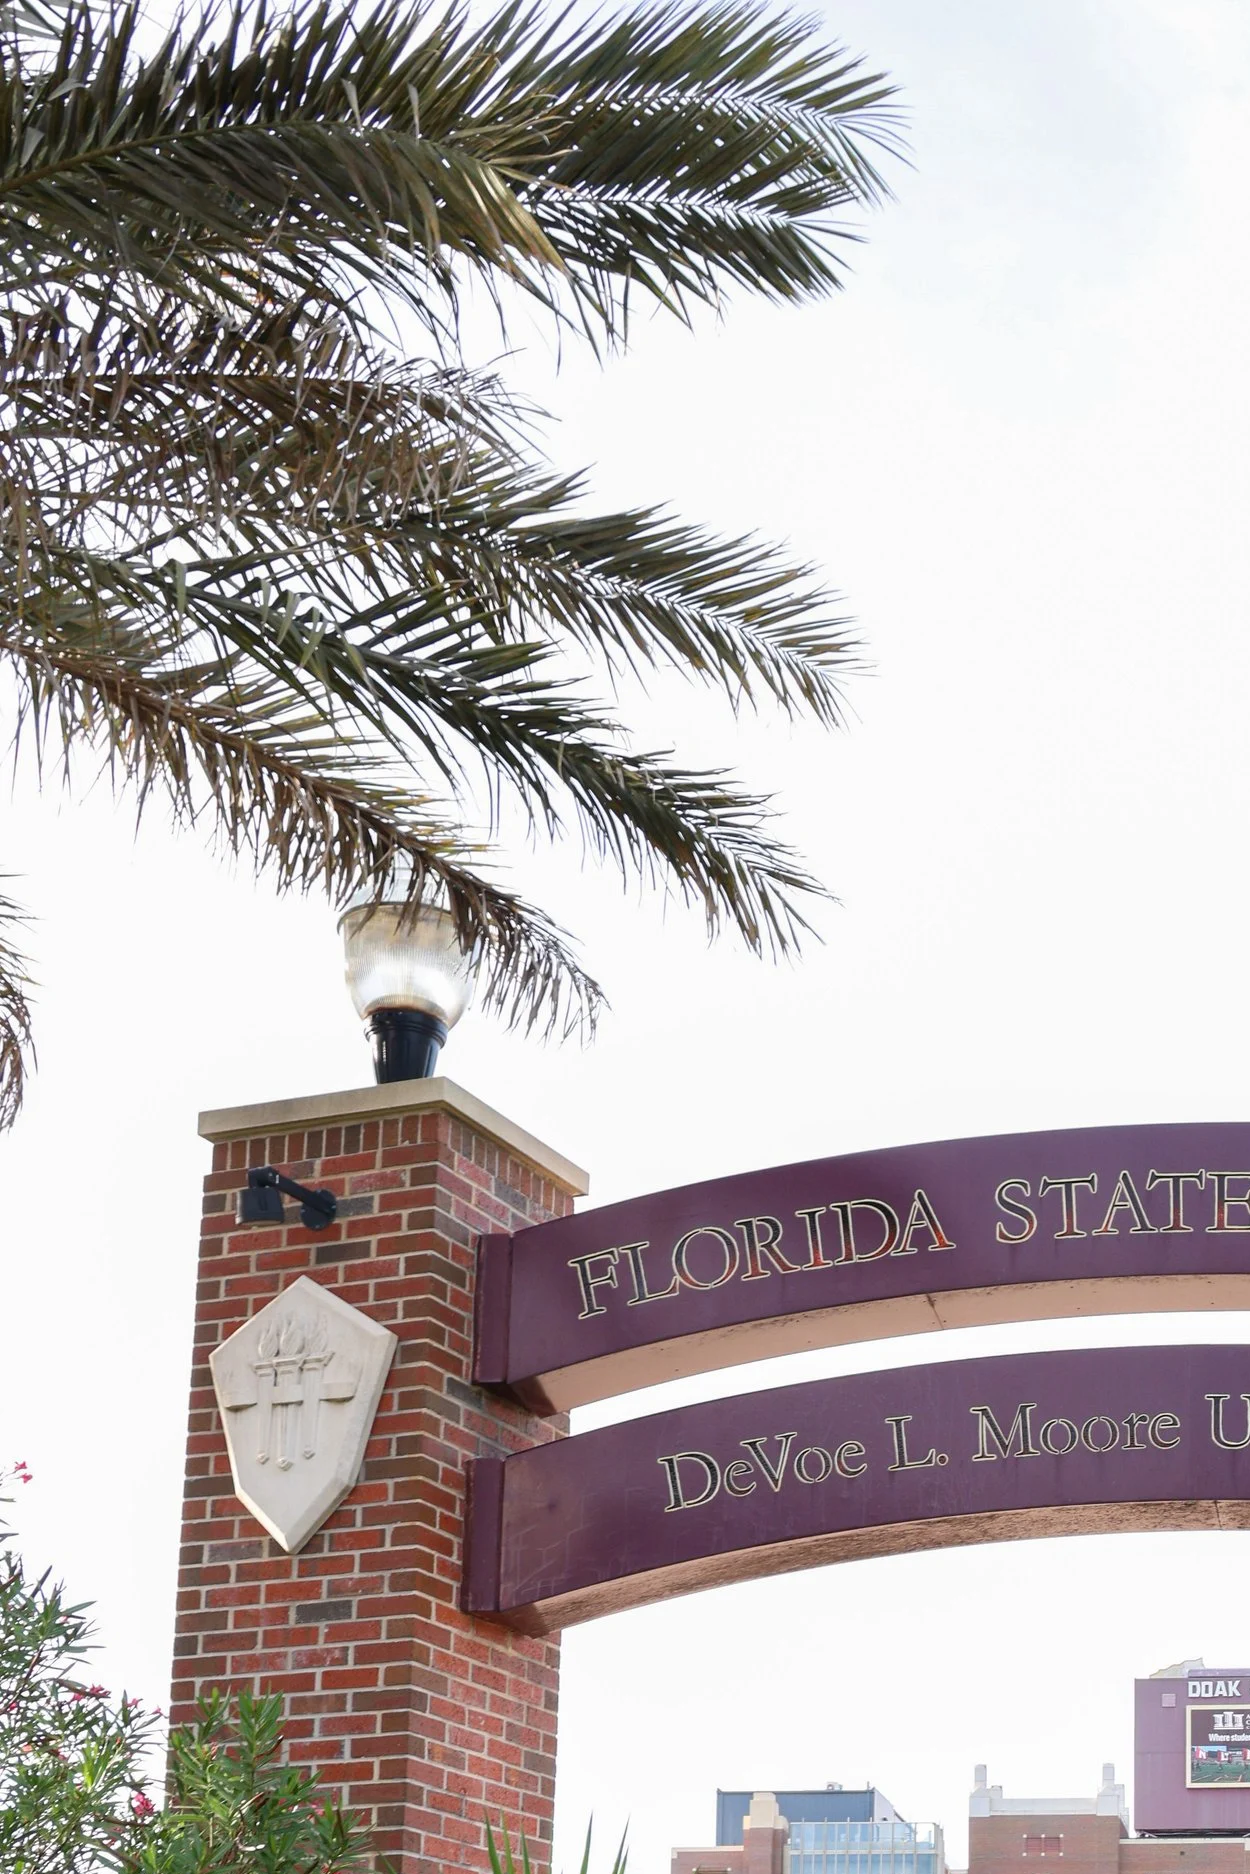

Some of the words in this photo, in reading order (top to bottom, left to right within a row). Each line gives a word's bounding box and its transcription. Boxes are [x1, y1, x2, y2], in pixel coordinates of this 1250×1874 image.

[567, 1189, 957, 1320] FLORIDA
[657, 1432, 868, 1513] DeVoe
[884, 1415, 950, 1472] L.
[969, 1403, 1181, 1462] Moore
[1187, 1680, 1241, 1698] DOAK
[1208, 1733, 1230, 1742] Where
